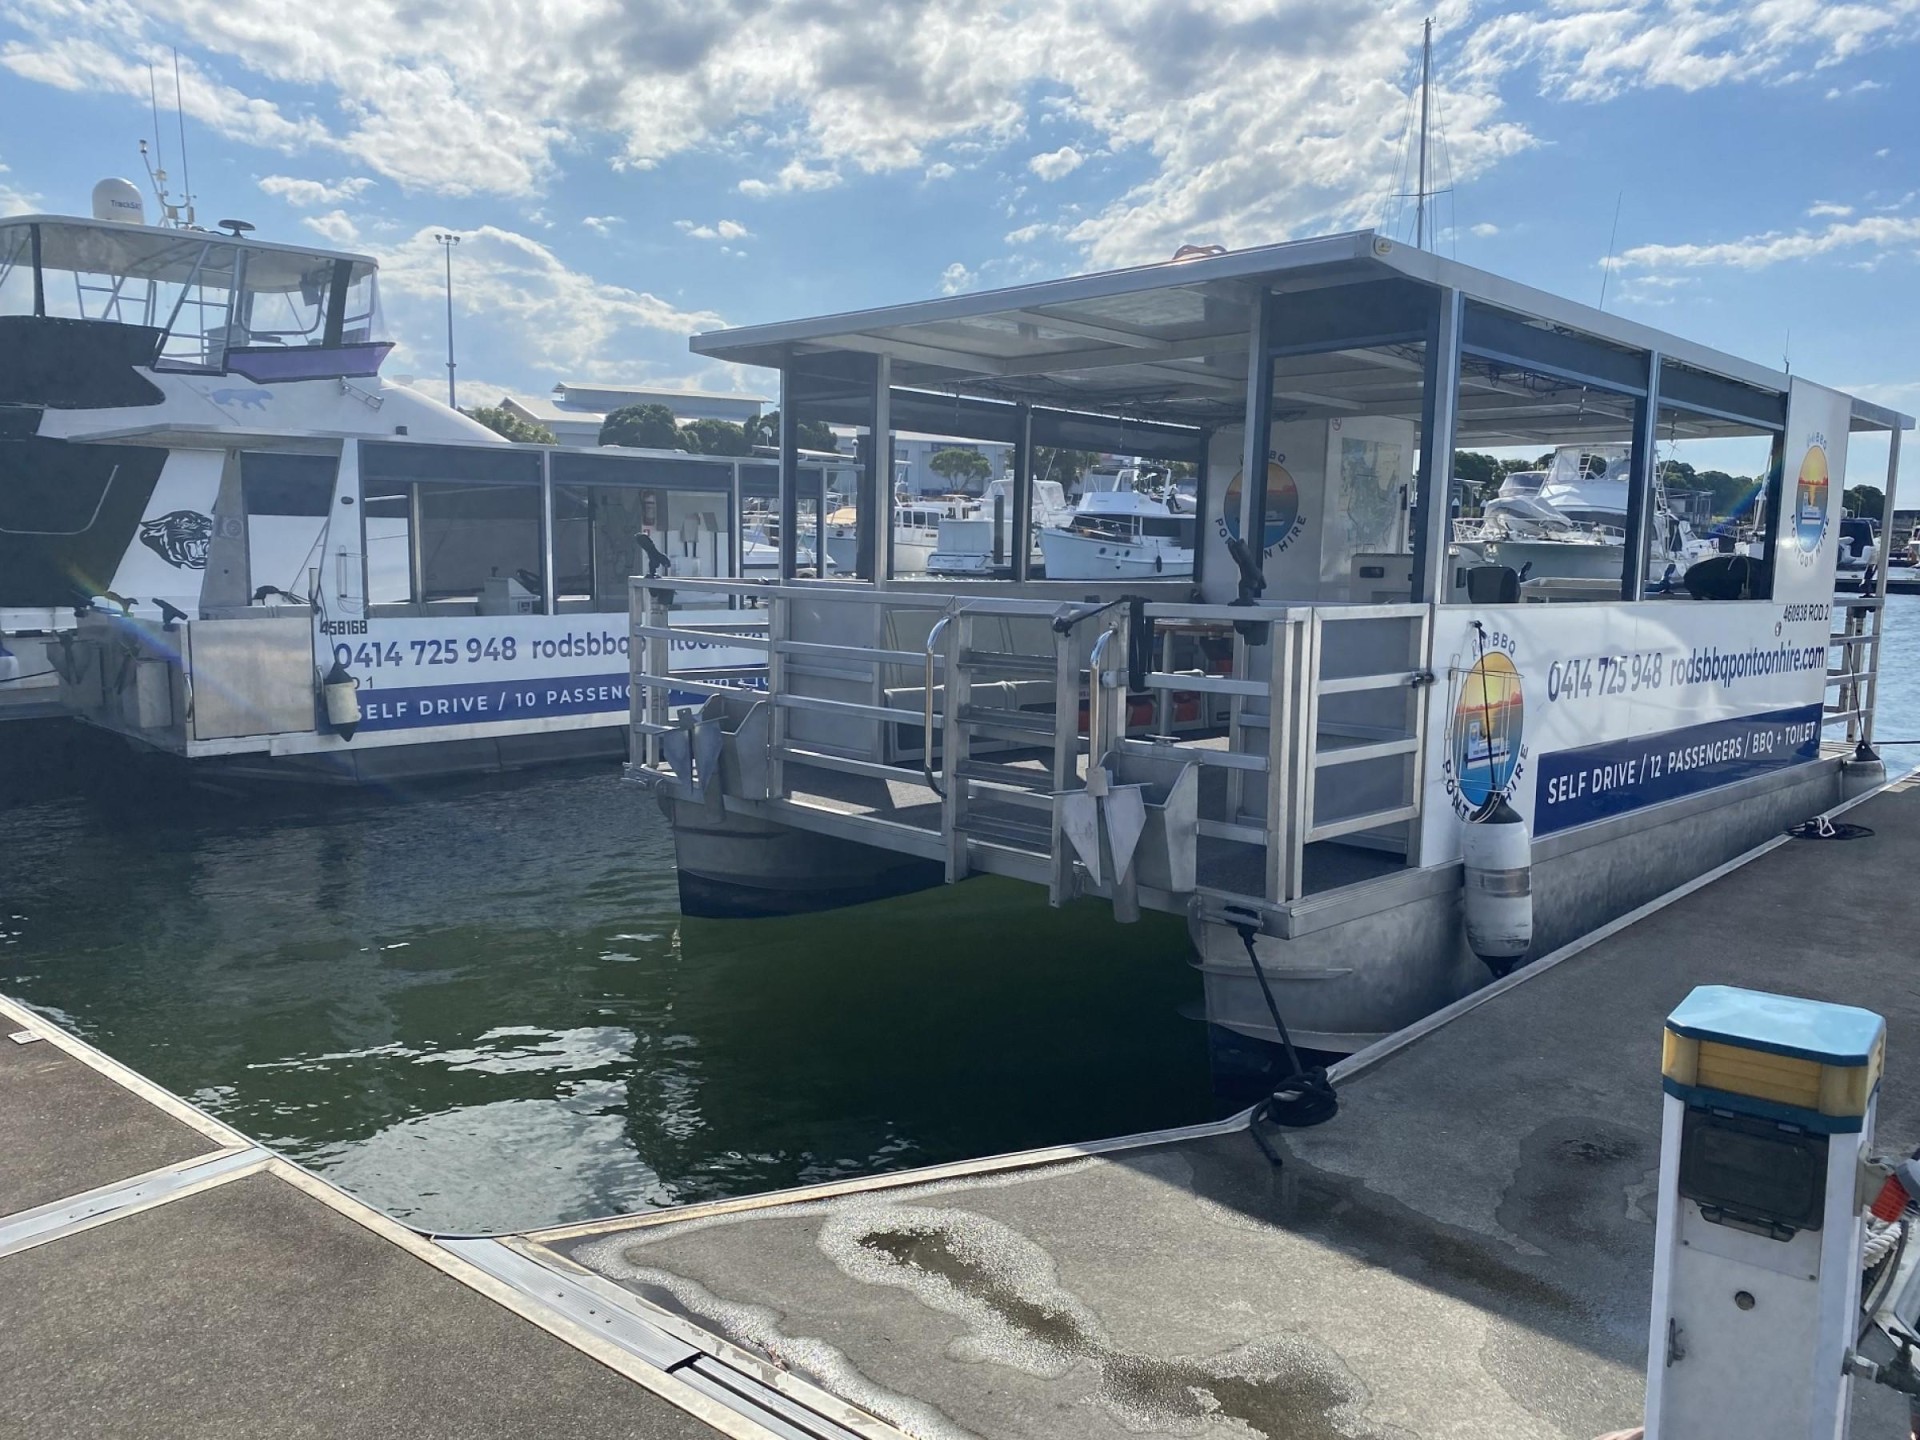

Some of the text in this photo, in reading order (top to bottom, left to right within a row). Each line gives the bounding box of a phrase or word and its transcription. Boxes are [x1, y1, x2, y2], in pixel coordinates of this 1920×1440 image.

[1278, 515, 1307, 552] HIRE
[1783, 604, 1830, 622] 460938 ROD 2
[320, 620, 368, 636] 458168
[335, 641, 403, 669] 0414
[410, 639, 459, 666] 725
[466, 636, 517, 663] 948
[1492, 631, 1516, 658] BBQ
[365, 675, 373, 689] 1
[1548, 640, 1825, 702] 0414 725 948 rodsbbqpontoonhire.com
[419, 695, 488, 716] DRIVE
[498, 691, 507, 711] /
[515, 692, 537, 708] 10
[1547, 771, 1586, 804] SELF
[1592, 760, 1635, 793] DRIVE
[1639, 753, 1648, 785] /
[1650, 755, 1661, 780] 12
[1668, 736, 1741, 774] PASSENGERS
[1744, 732, 1751, 758] /
[1752, 730, 1773, 755] BBQ
[1785, 721, 1816, 745] TOILET
